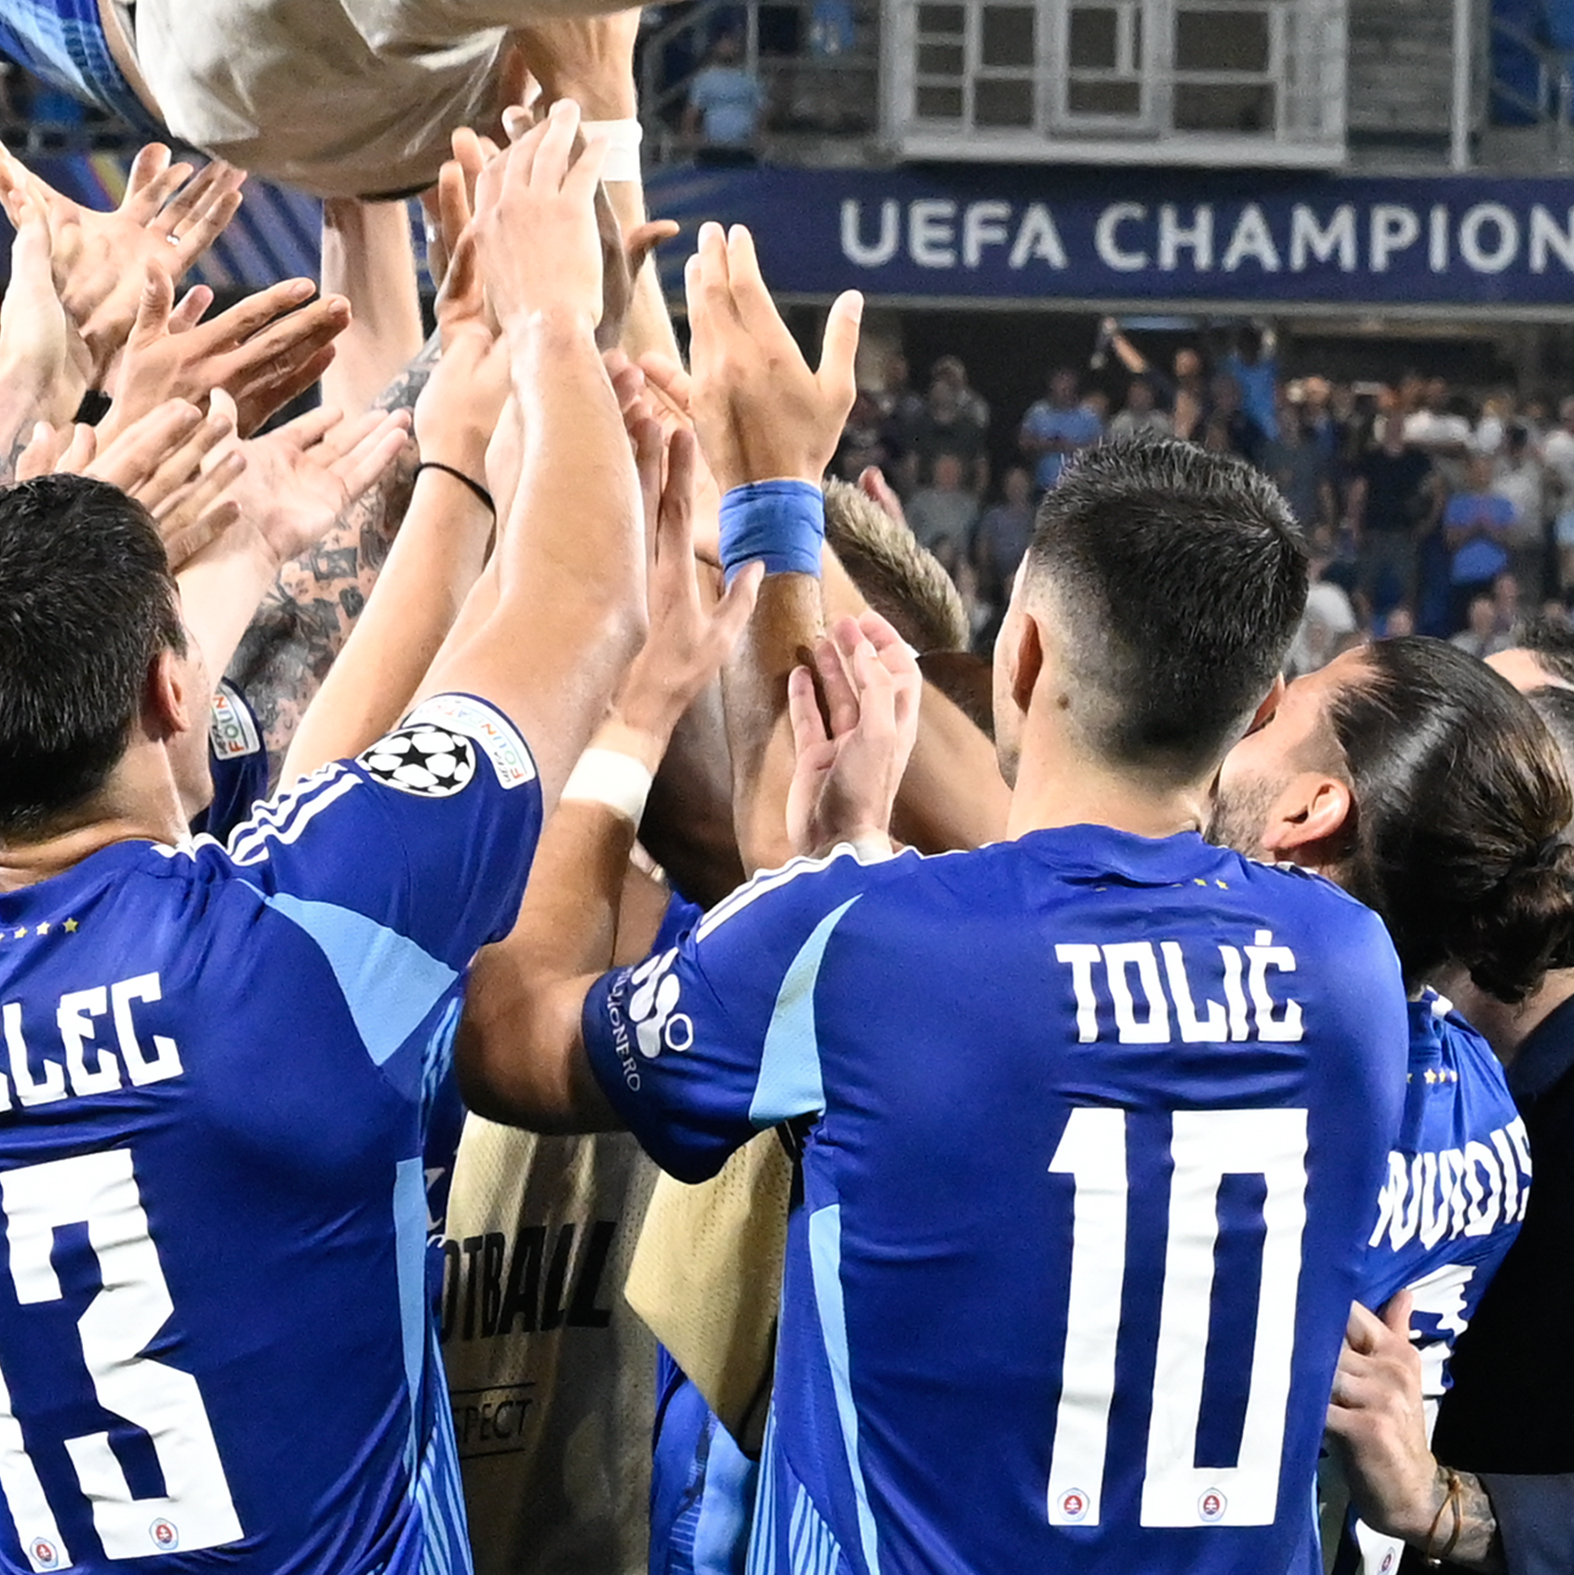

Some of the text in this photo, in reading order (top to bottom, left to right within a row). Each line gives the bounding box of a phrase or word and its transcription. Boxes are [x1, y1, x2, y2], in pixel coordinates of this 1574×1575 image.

[840, 199, 1067, 270] UEFA
[1055, 929, 1304, 1044] TOLIĆ
[1047, 1107, 1309, 1528] 10
